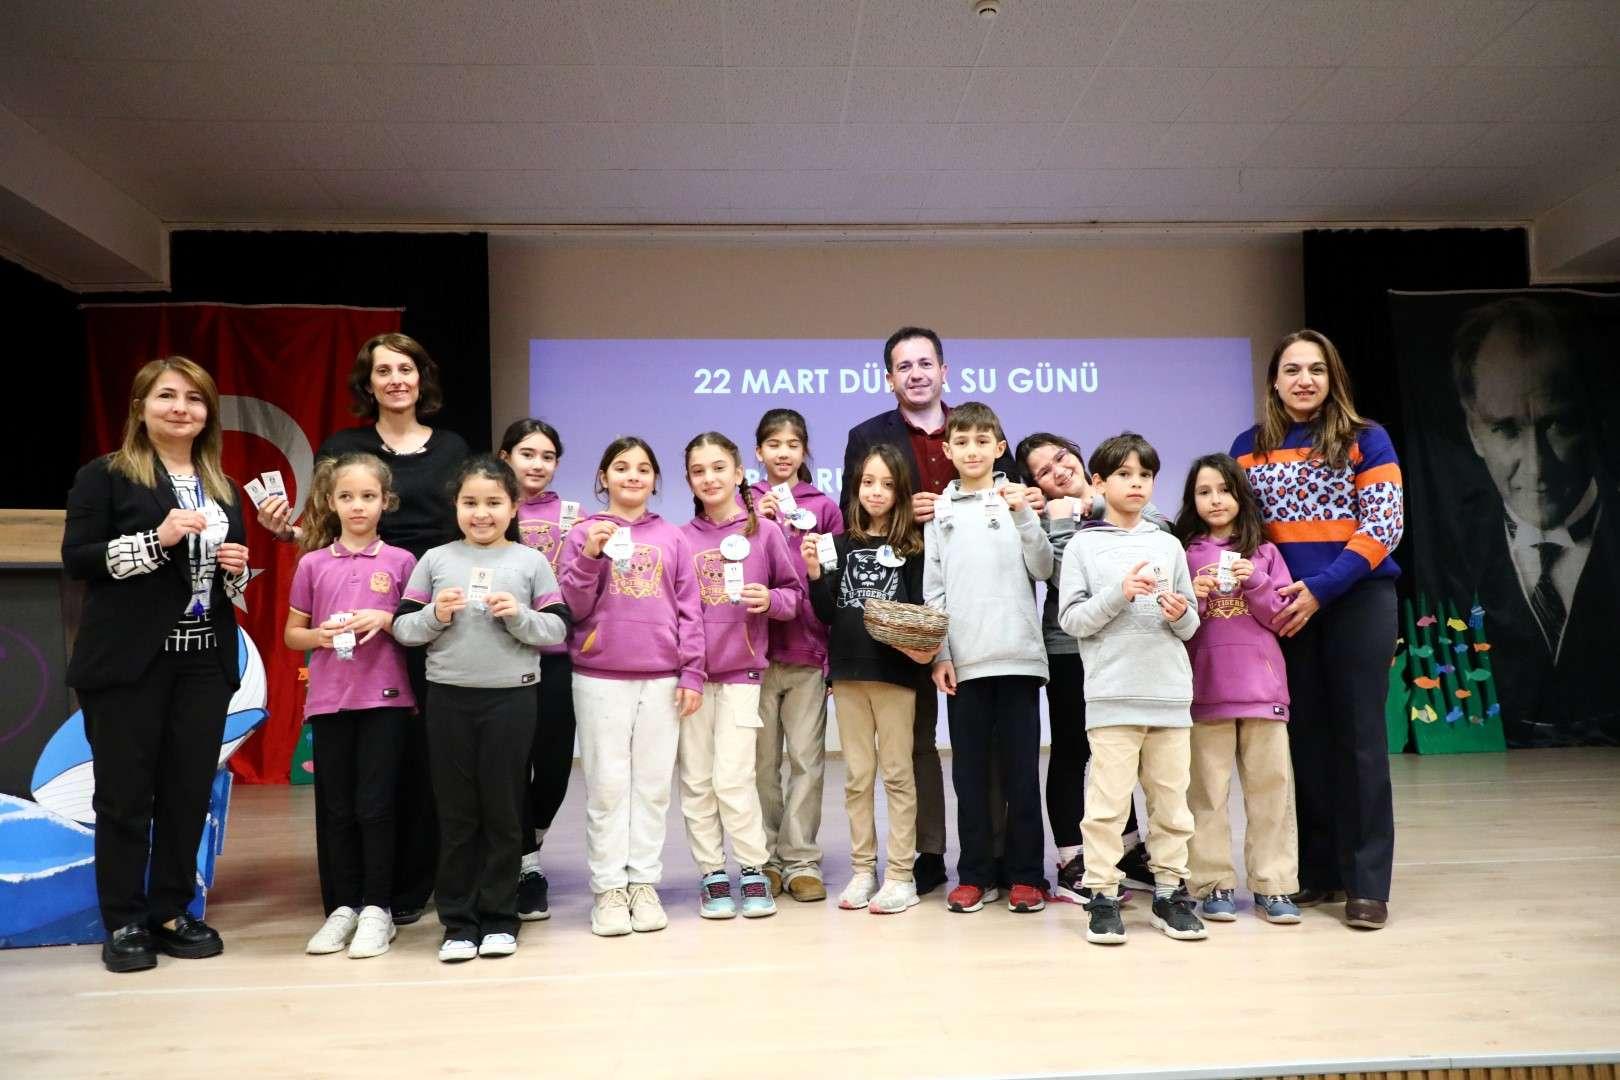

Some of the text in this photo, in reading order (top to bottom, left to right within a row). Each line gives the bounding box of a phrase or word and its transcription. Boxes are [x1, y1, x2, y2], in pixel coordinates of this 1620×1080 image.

[693, 368, 731, 394] 22
[741, 368, 829, 394] MART
[960, 367, 997, 393] SU
[1007, 362, 1098, 393] GÜNÜ
